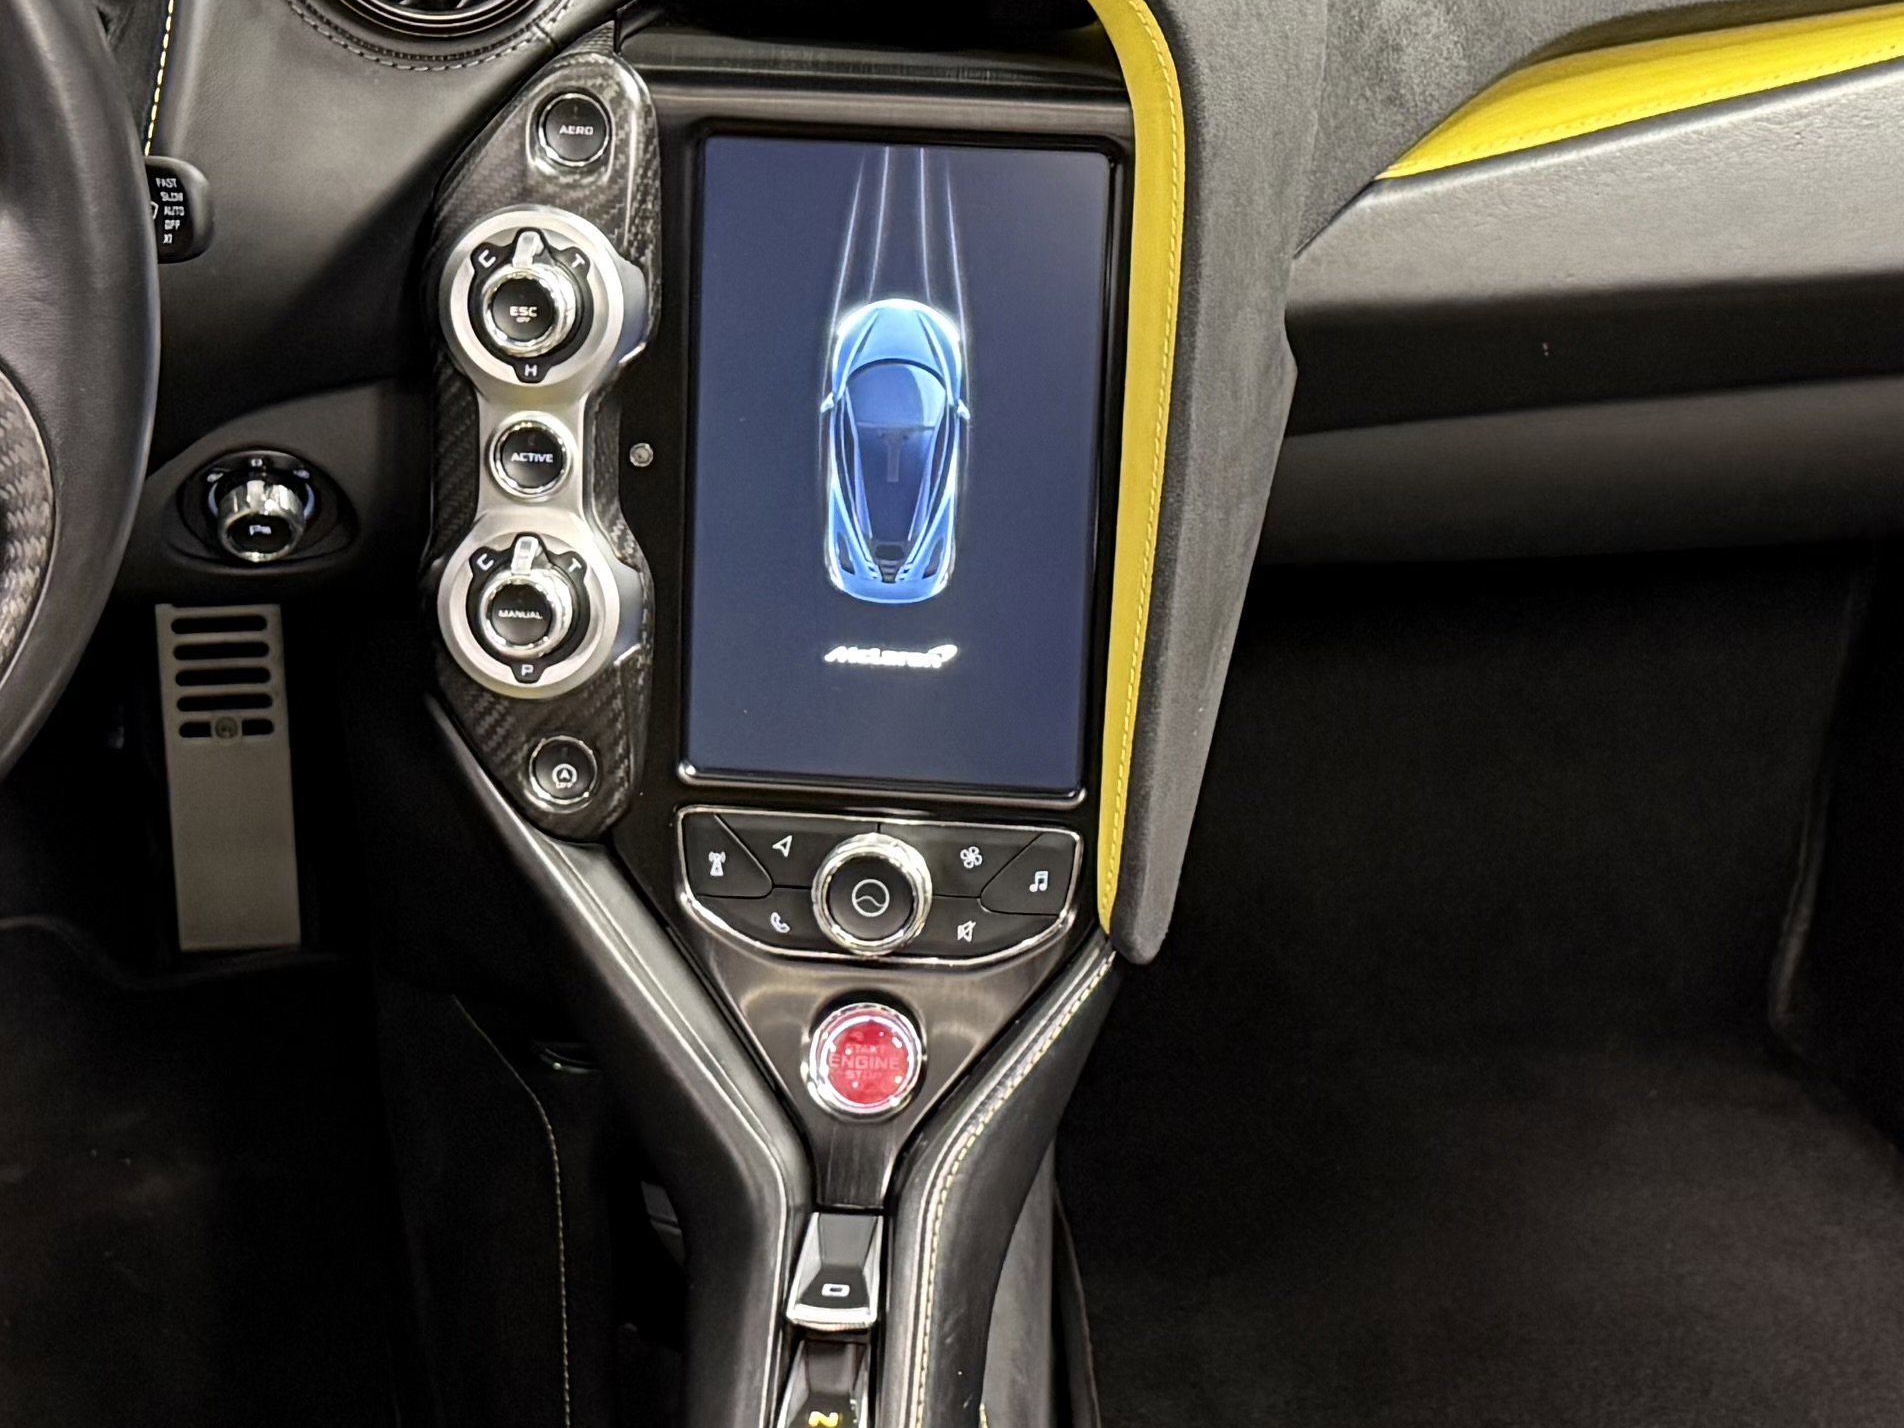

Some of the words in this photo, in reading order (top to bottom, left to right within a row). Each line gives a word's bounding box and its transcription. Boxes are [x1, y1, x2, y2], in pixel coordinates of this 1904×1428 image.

[559, 124, 594, 136] AERO
[156, 177, 177, 188] FAST
[478, 249, 496, 269] C
[571, 253, 586, 268] T
[509, 305, 538, 318] ESC
[524, 364, 538, 377] H
[510, 452, 554, 464] ACTIVE
[476, 553, 495, 571] C
[569, 557, 583, 573] T
[498, 609, 544, 620] MANUAL
[521, 664, 534, 676] P
[828, 1052, 901, 1070] ENGINE
[821, 1283, 850, 1297] D
[807, 1410, 839, 1428] N
